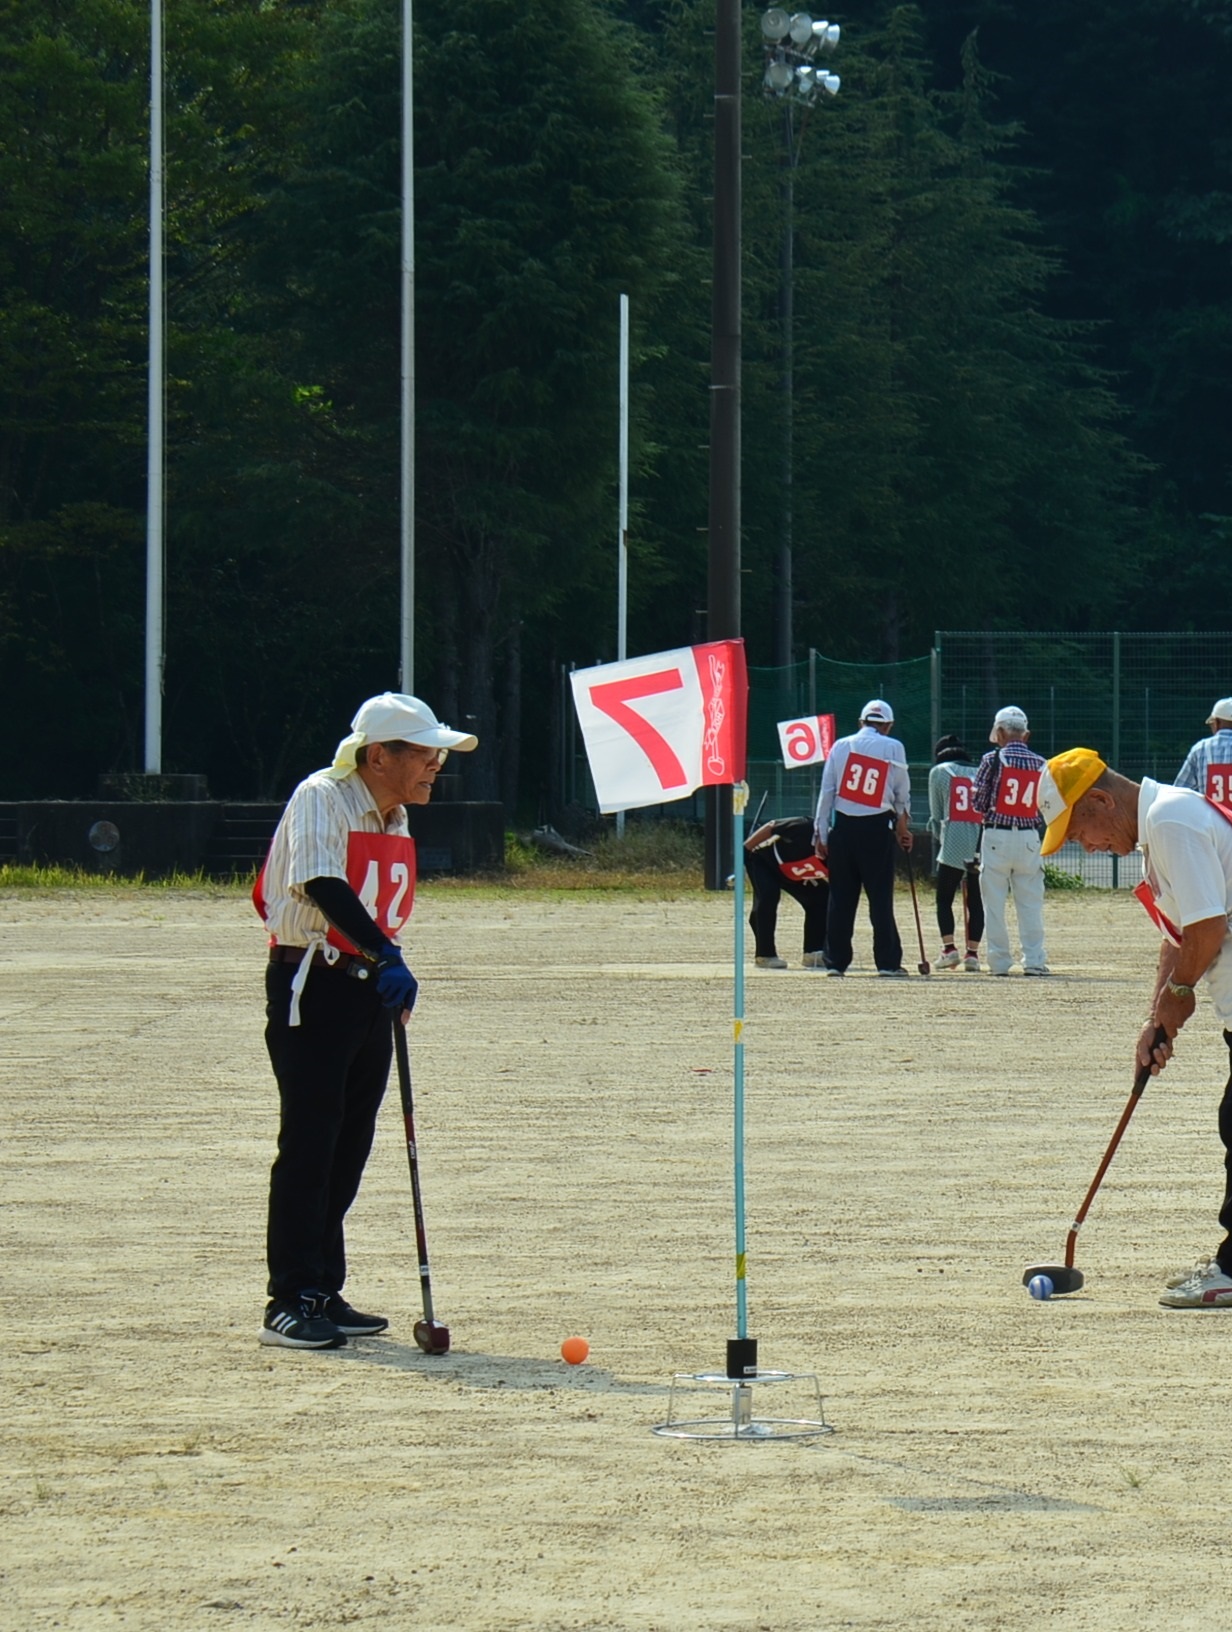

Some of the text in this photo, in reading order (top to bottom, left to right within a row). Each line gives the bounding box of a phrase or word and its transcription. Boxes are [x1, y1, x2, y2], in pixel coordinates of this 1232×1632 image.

[846, 763, 880, 795] 36
[1004, 778, 1035, 808] 34
[955, 786, 981, 814] 3
[358, 860, 409, 929] 42
